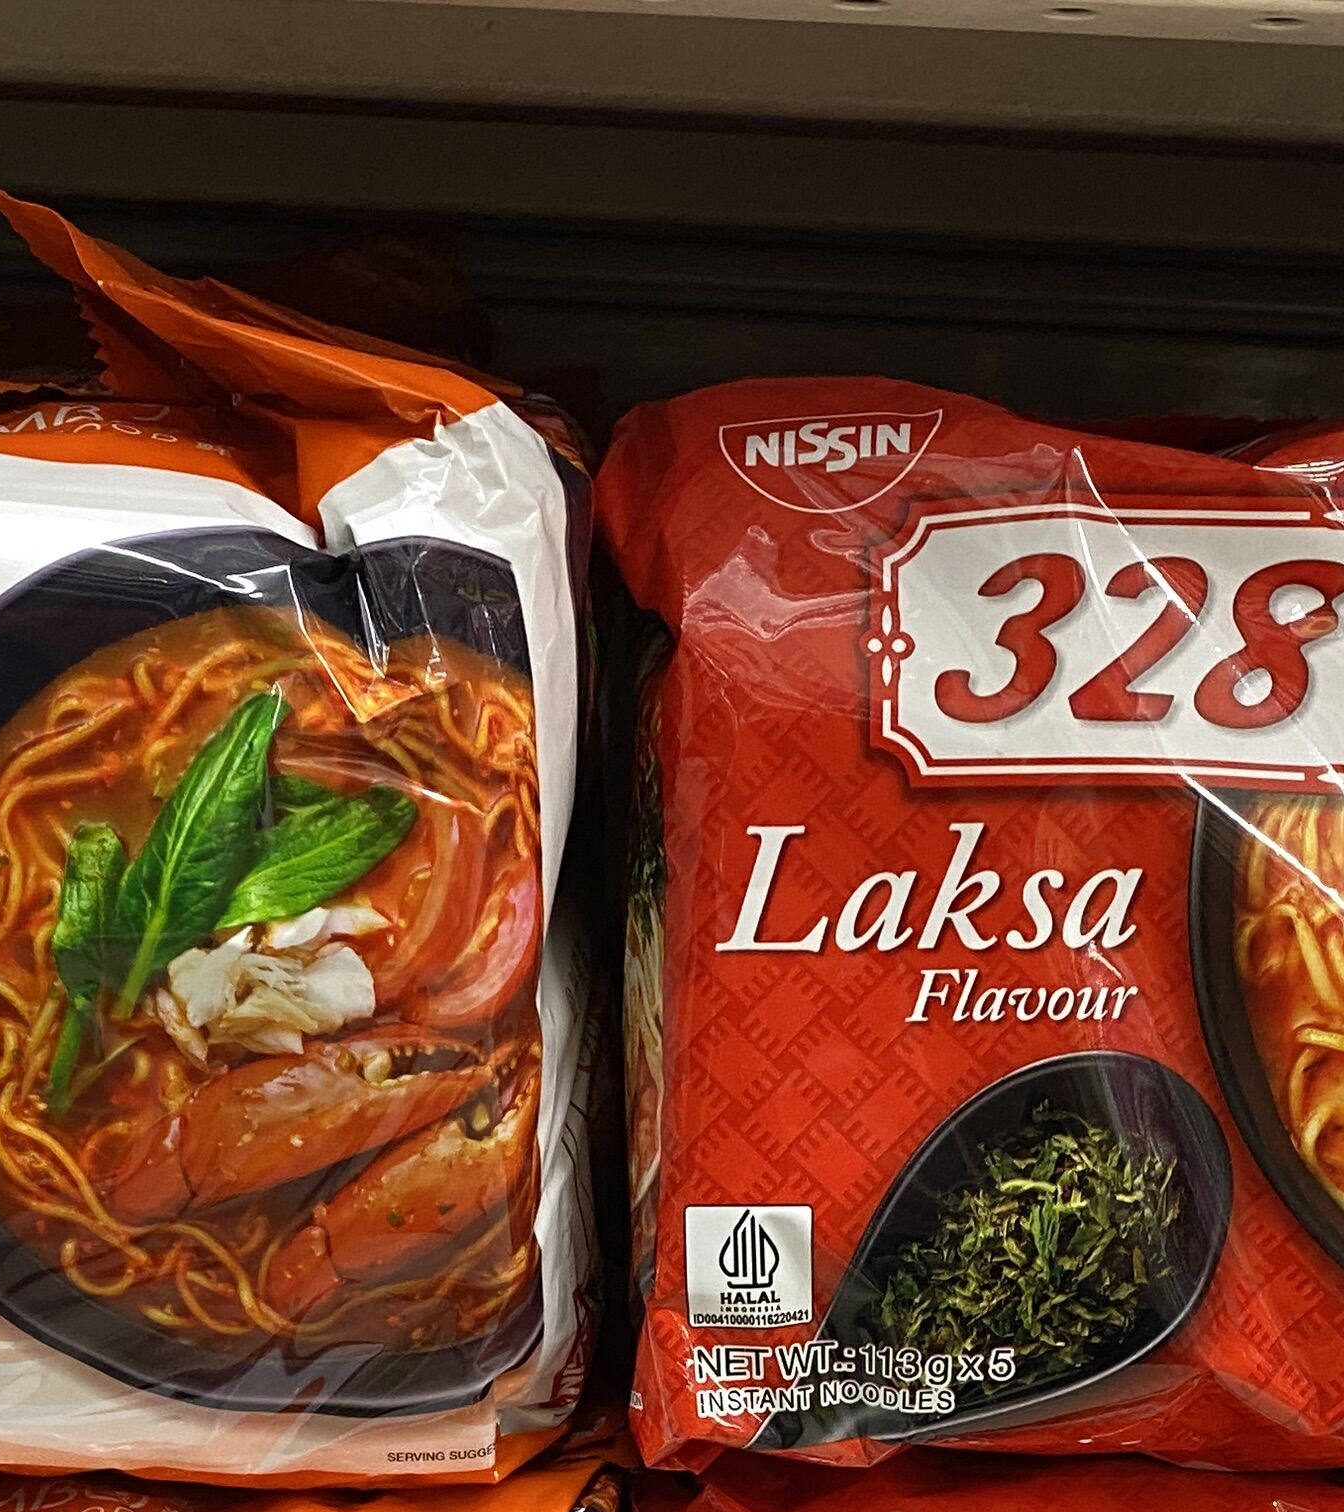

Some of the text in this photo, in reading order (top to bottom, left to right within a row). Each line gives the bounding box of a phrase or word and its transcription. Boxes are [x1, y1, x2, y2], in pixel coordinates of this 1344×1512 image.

[744, 421, 912, 472] NISSIN
[715, 822, 1144, 954] Laksa
[905, 967, 1139, 1024] Flavour
[719, 1291, 781, 1304] HALAL
[719, 1304, 781, 1313] INDONESIA
[696, 1346, 768, 1380] NET
[699, 1381, 956, 1414] INSTANT NOODLES
[387, 1450, 445, 1463] SERVING
